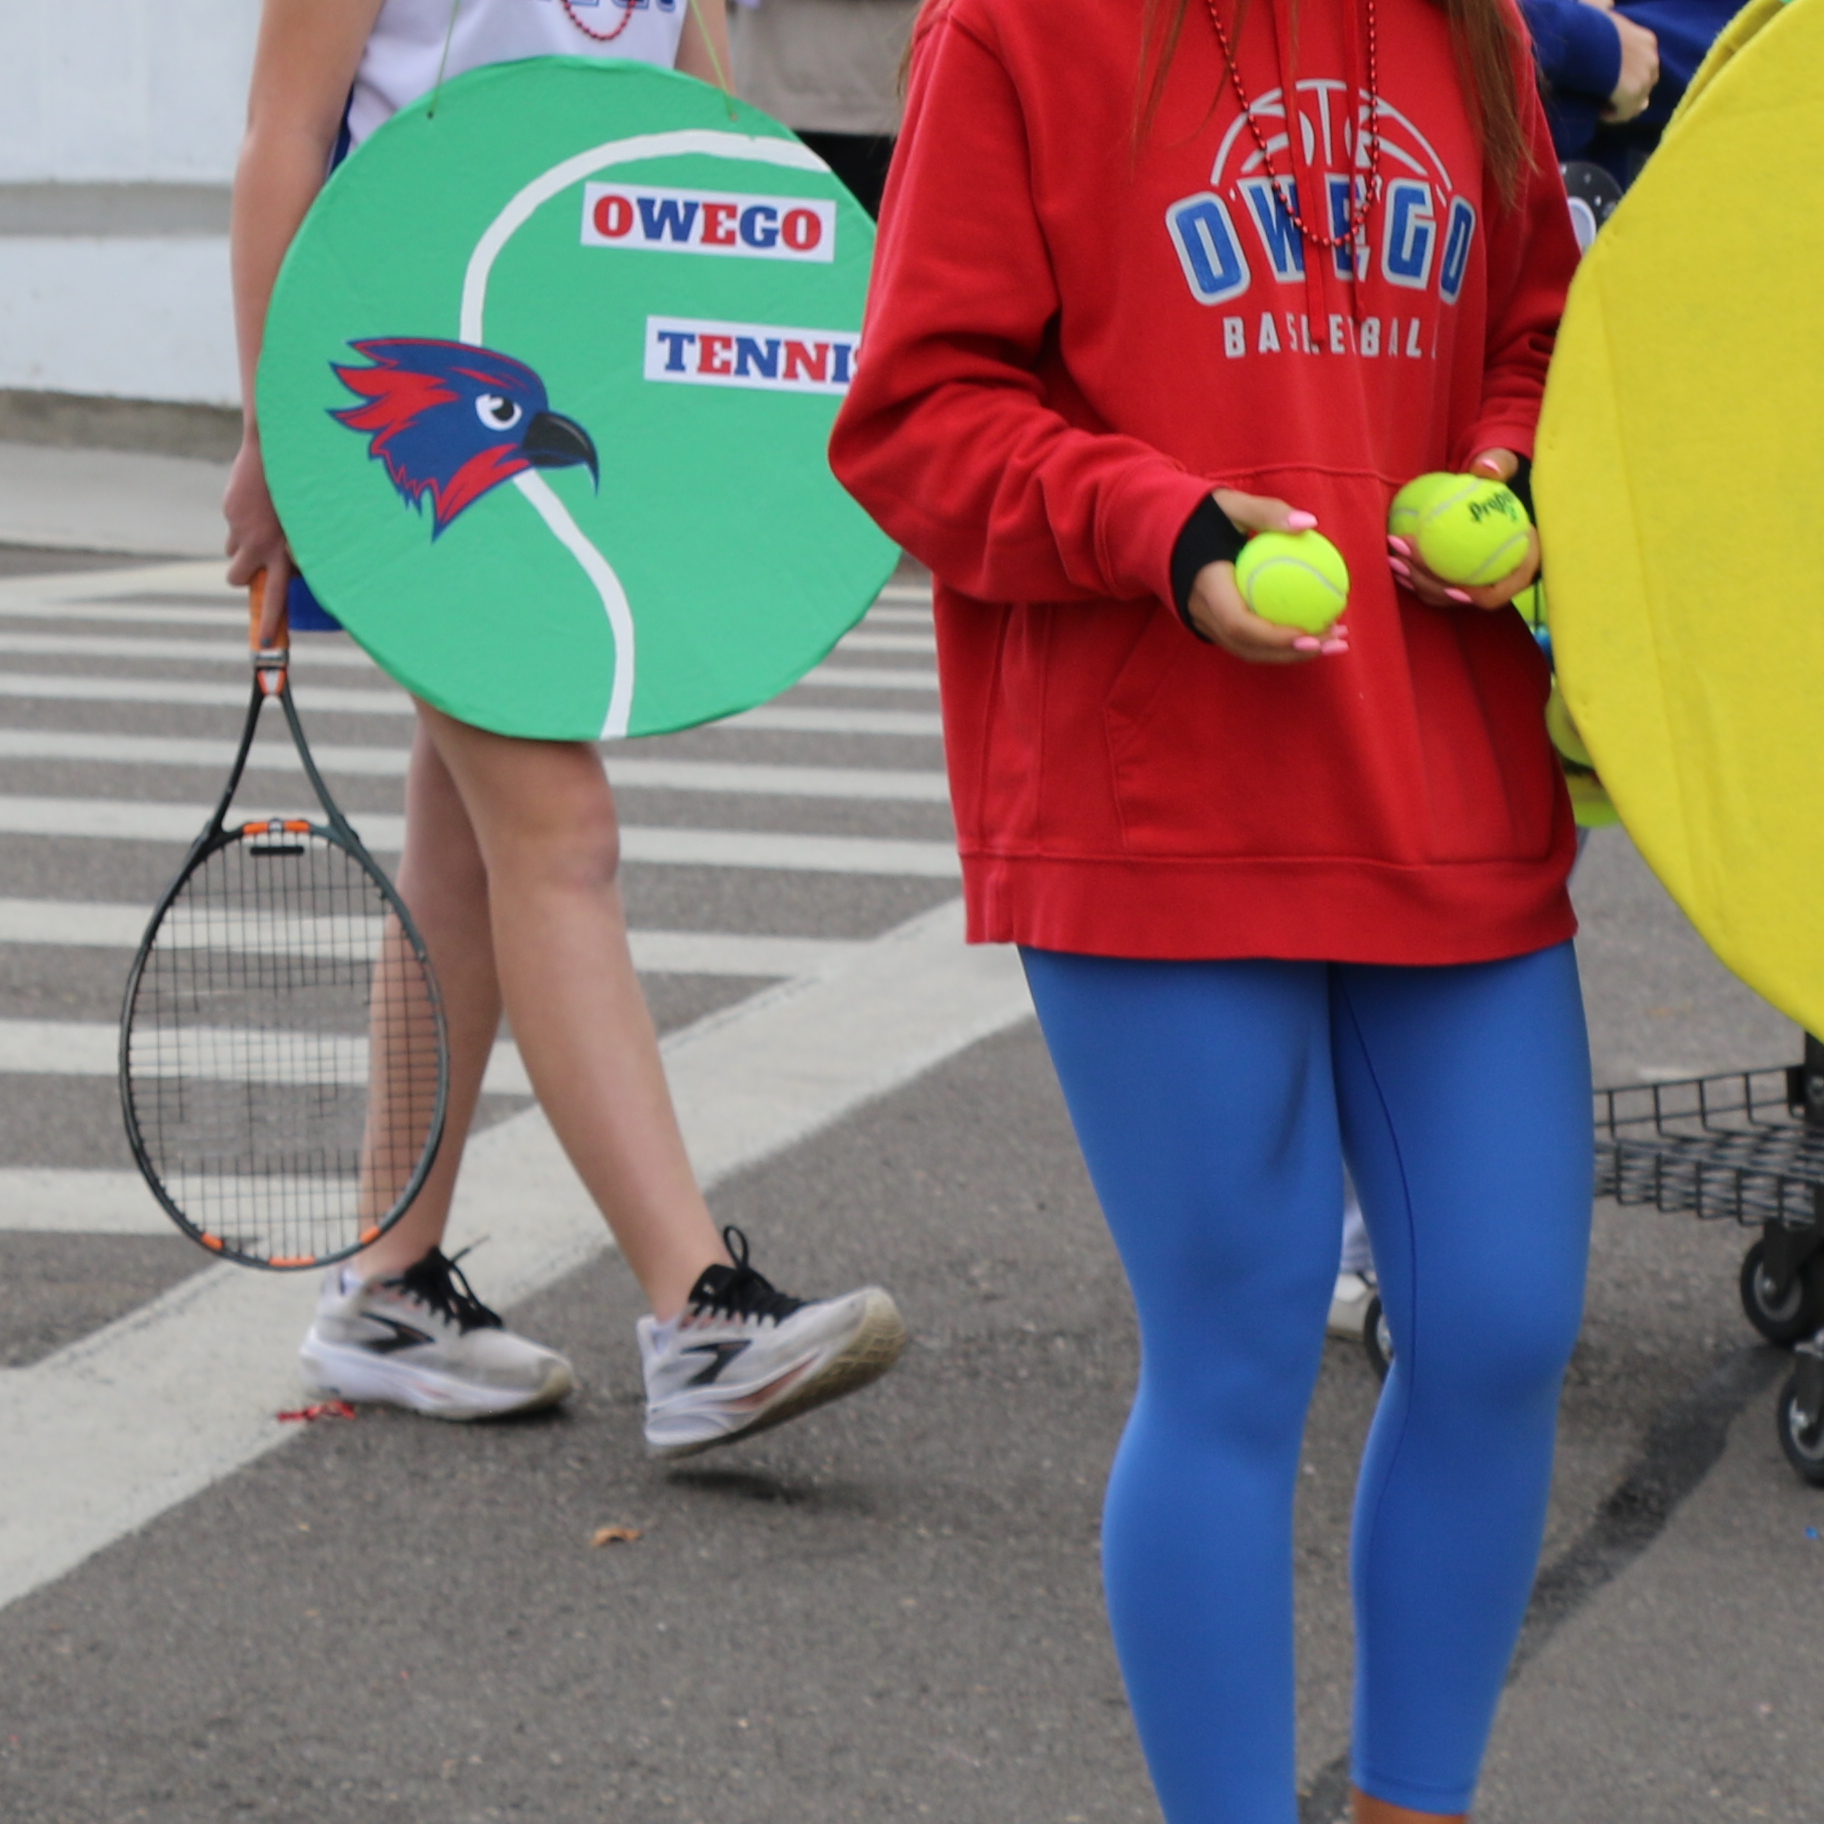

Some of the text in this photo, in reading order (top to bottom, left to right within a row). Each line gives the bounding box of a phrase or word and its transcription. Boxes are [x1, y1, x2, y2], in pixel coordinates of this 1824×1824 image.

[592, 194, 823, 253] OWEGO
[1165, 171, 1476, 306] OWEGO
[656, 330, 861, 384] TENNI
[1222, 311, 1438, 359] BASEBAL
